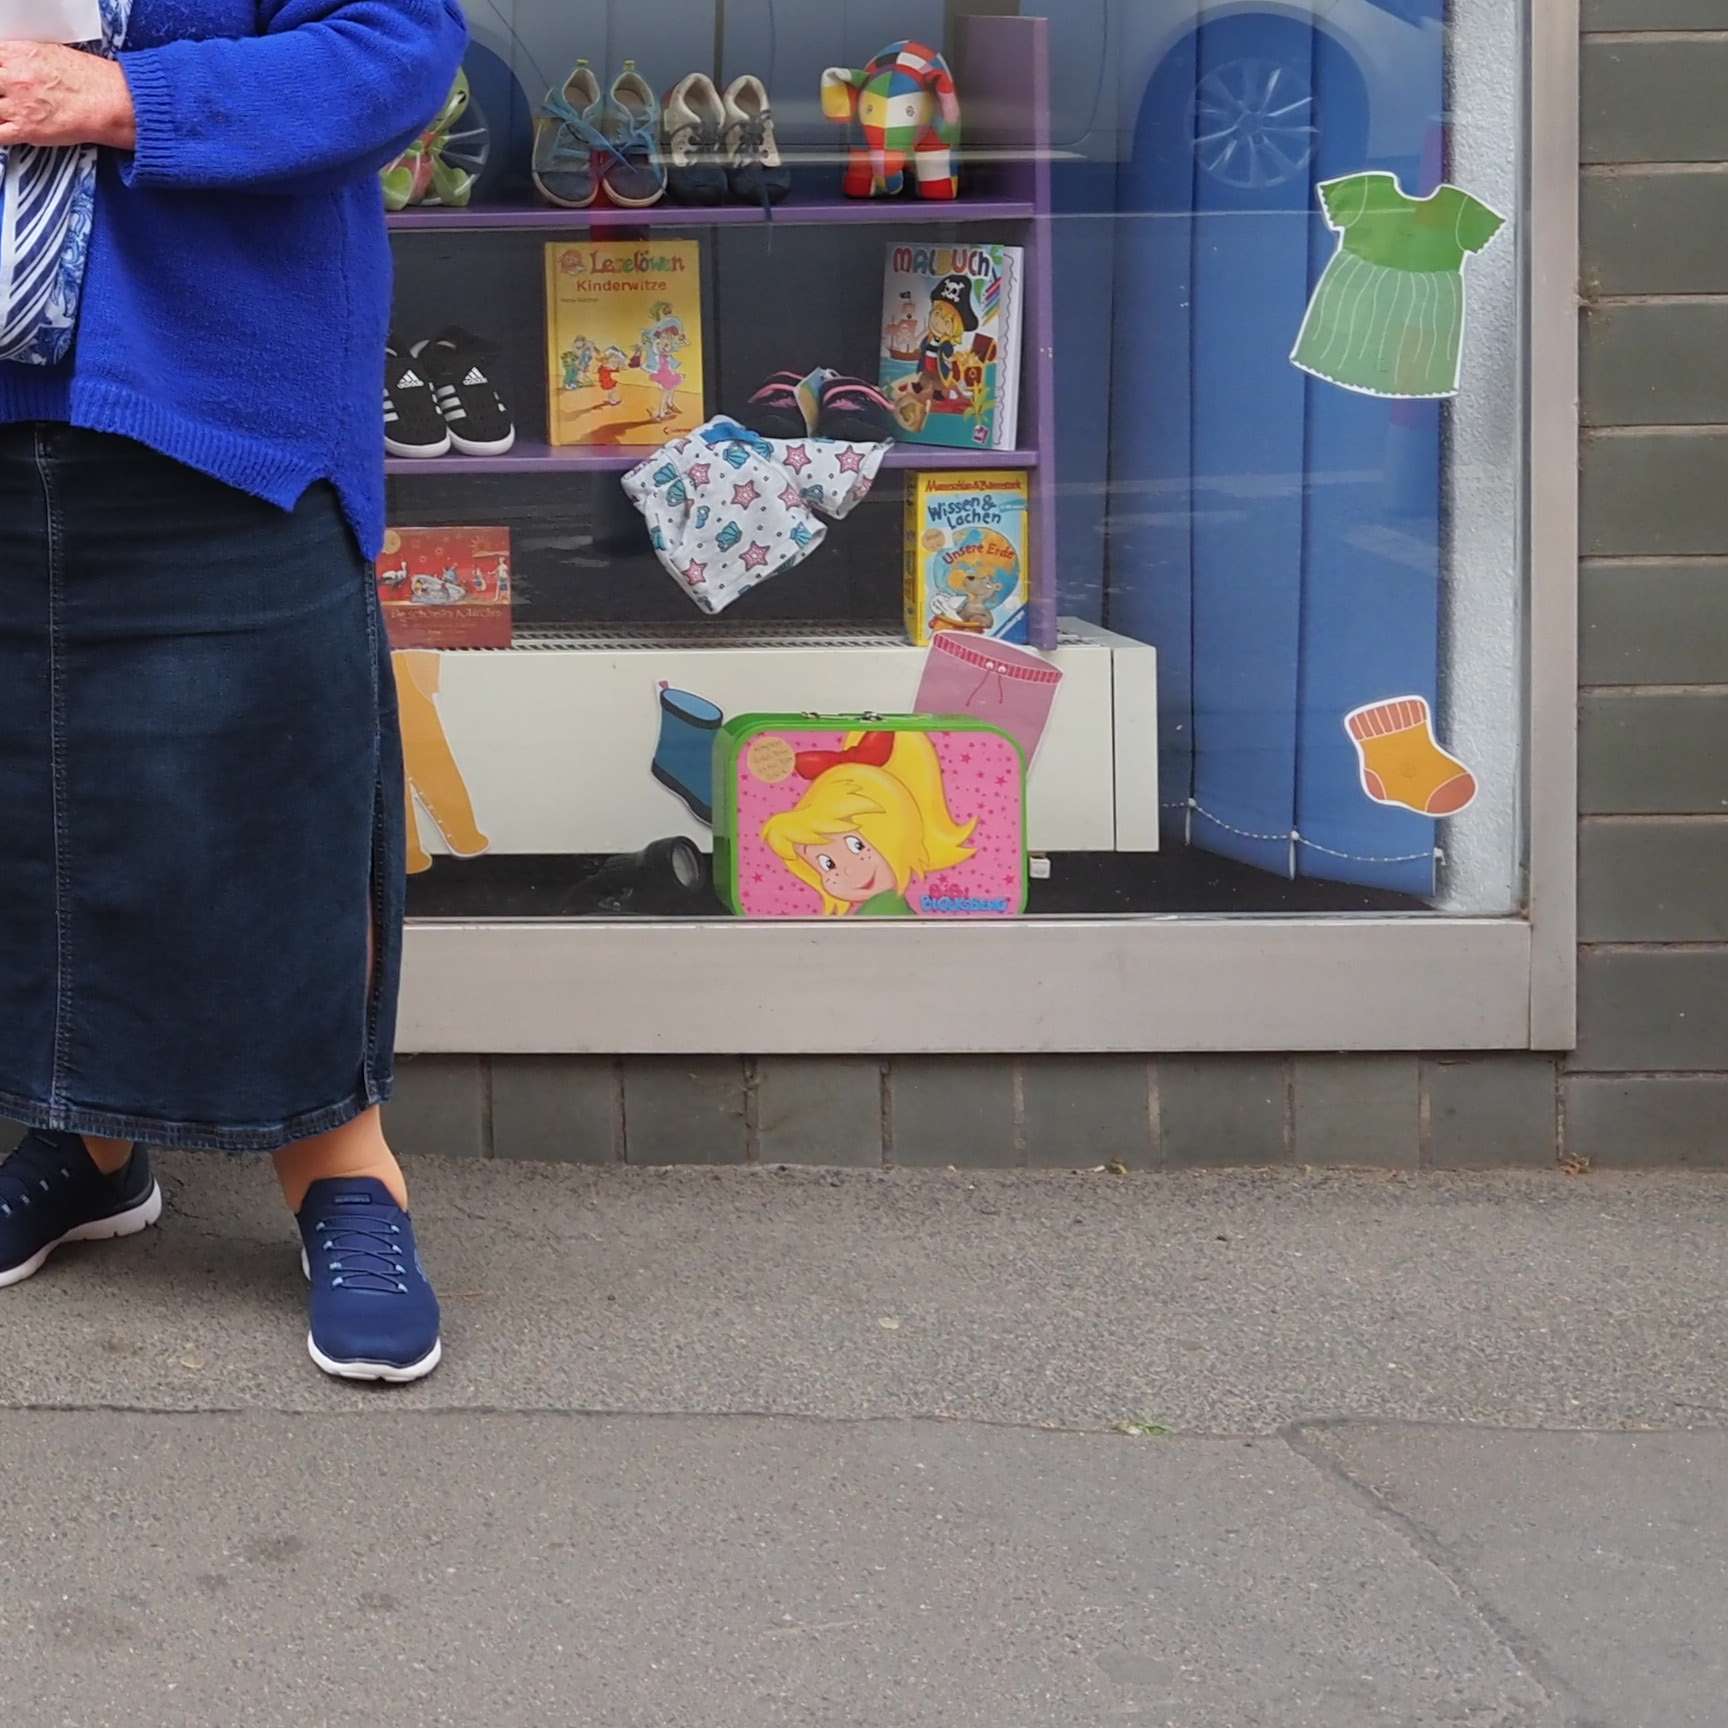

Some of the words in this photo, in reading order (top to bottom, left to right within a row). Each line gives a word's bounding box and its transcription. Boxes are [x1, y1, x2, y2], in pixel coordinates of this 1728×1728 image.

[589, 248, 687, 275] Leselöwen
[576, 280, 668, 292] Kinderwitze
[928, 497, 980, 522] Wissen
[981, 494, 997, 511] &
[947, 508, 1001, 530] Lachen
[942, 543, 984, 565] Unsere
[986, 543, 1015, 560] Erde
